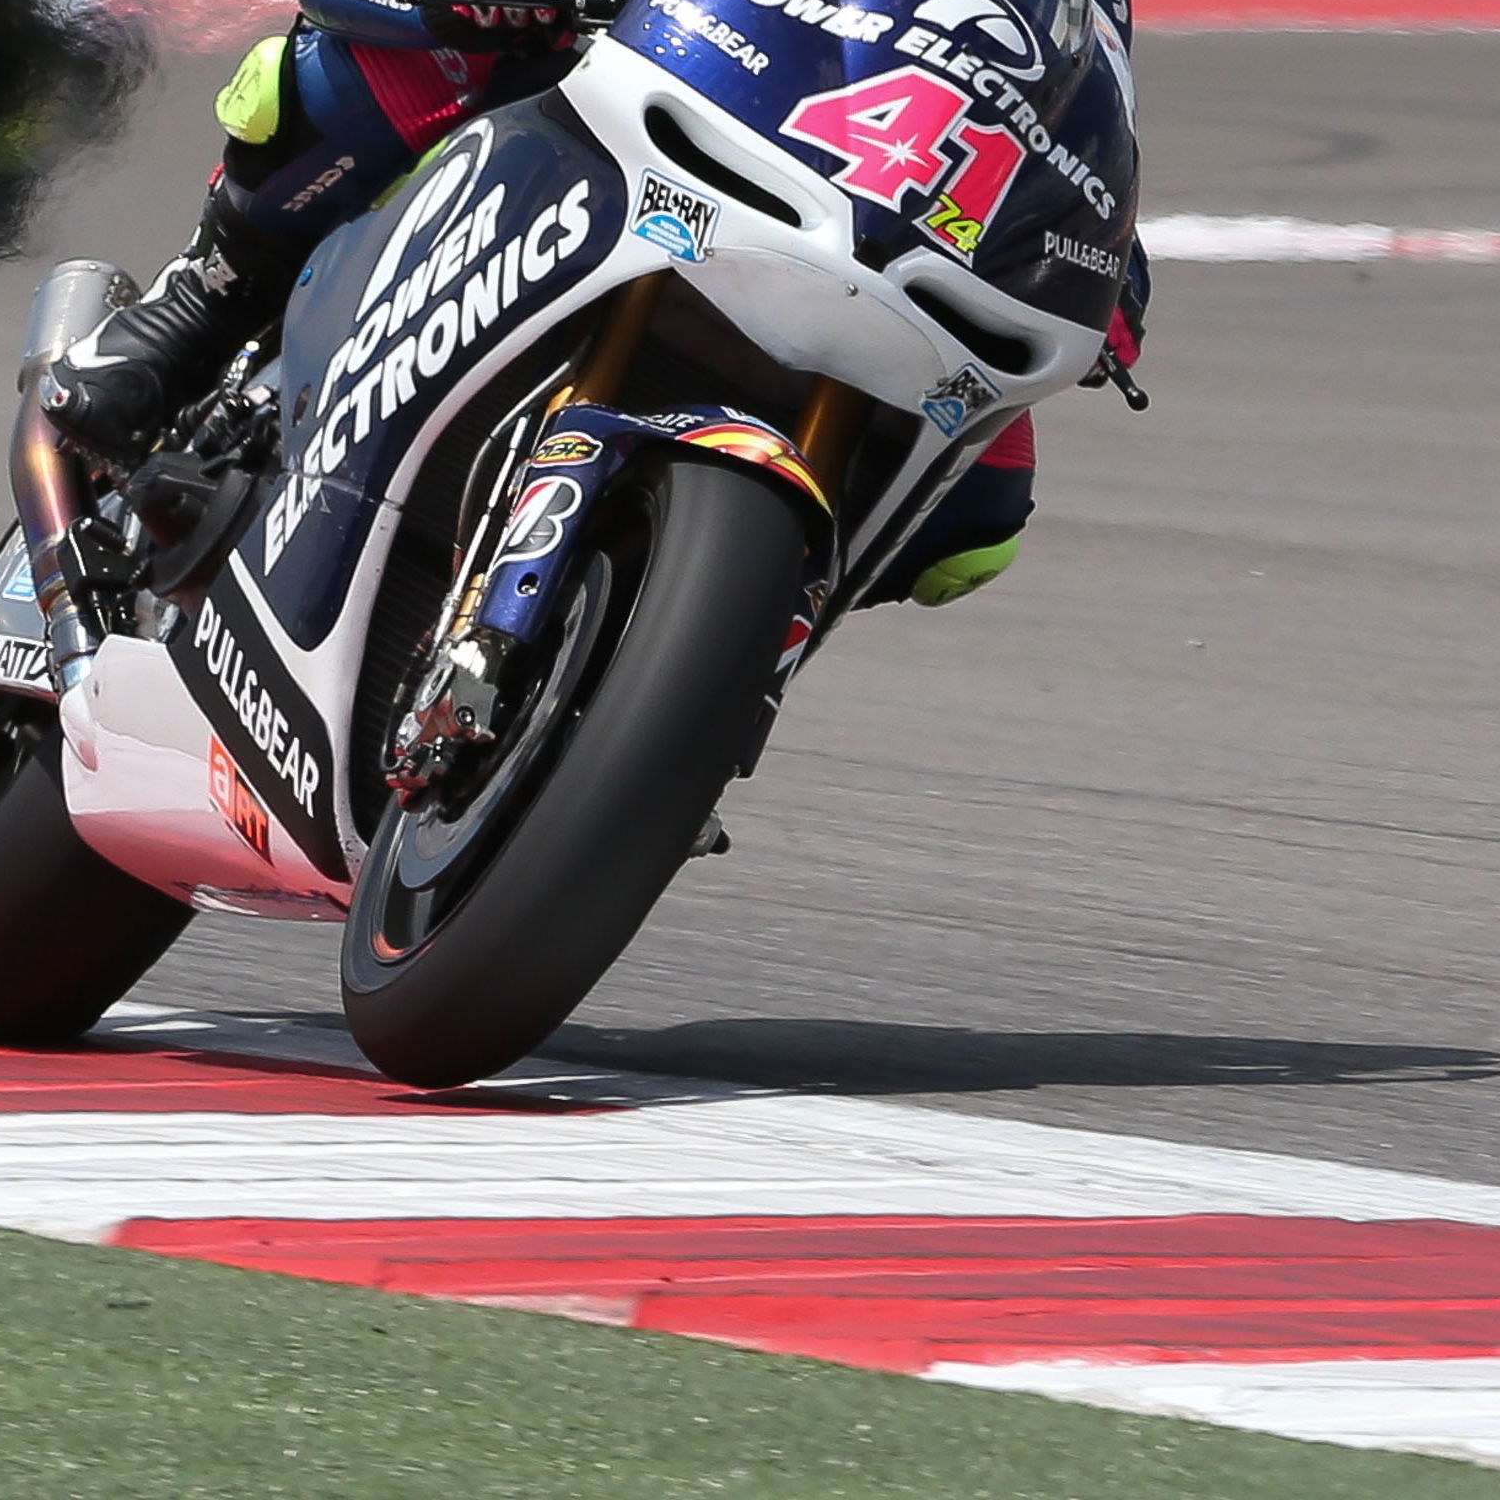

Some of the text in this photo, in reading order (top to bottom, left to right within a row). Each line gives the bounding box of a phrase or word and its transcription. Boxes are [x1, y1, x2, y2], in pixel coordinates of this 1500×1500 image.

[778, 64, 1028, 269] 41
[893, 26, 1117, 221] ELECTRONICS
[927, 194, 985, 254] 74
[316, 182, 506, 418] POWER
[1044, 230, 1121, 280] PULL&BEAR
[263, 178, 591, 577] ELECTRONICS
[194, 596, 320, 818] PULL&BEAR
